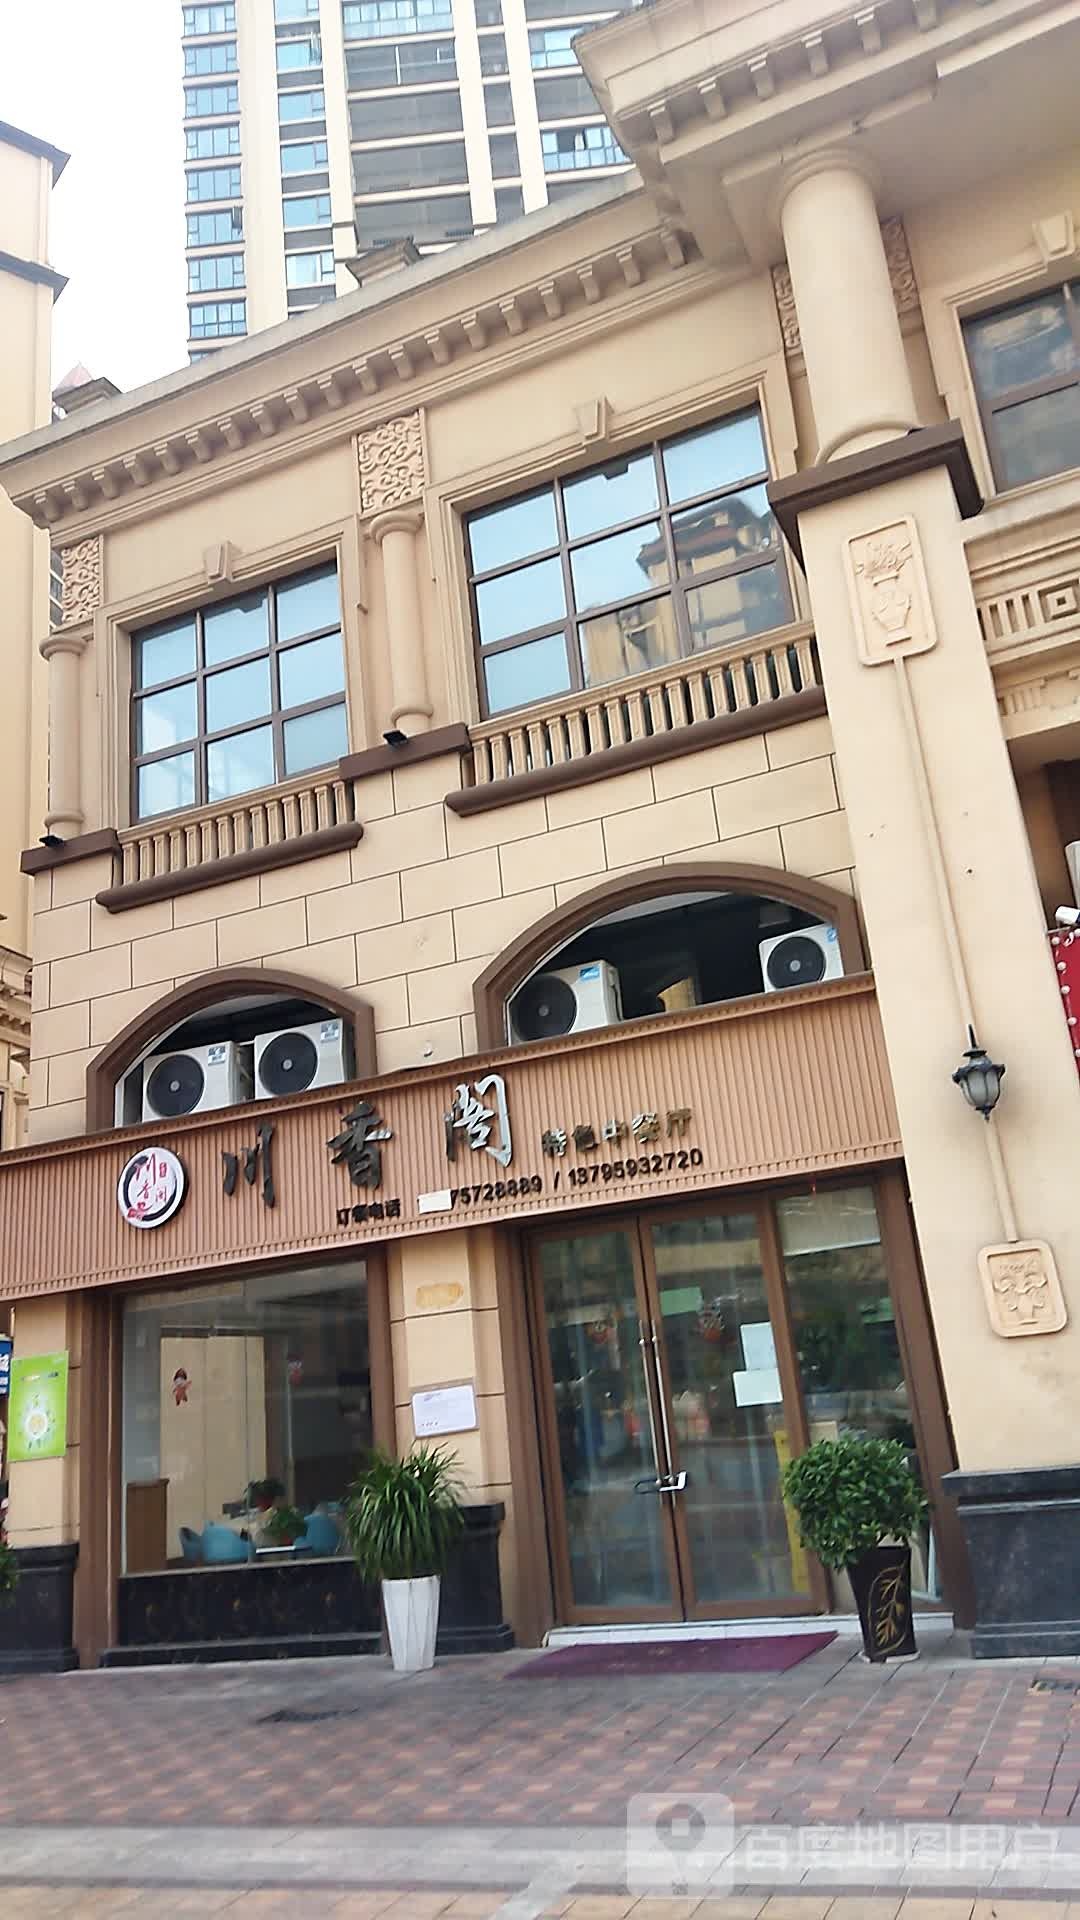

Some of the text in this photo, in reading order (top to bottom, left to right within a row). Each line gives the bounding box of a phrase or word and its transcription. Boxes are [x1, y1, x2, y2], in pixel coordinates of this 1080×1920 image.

[541, 1107, 693, 1158] 特色中餐厅
[336, 1197, 402, 1227] 订餐电话
